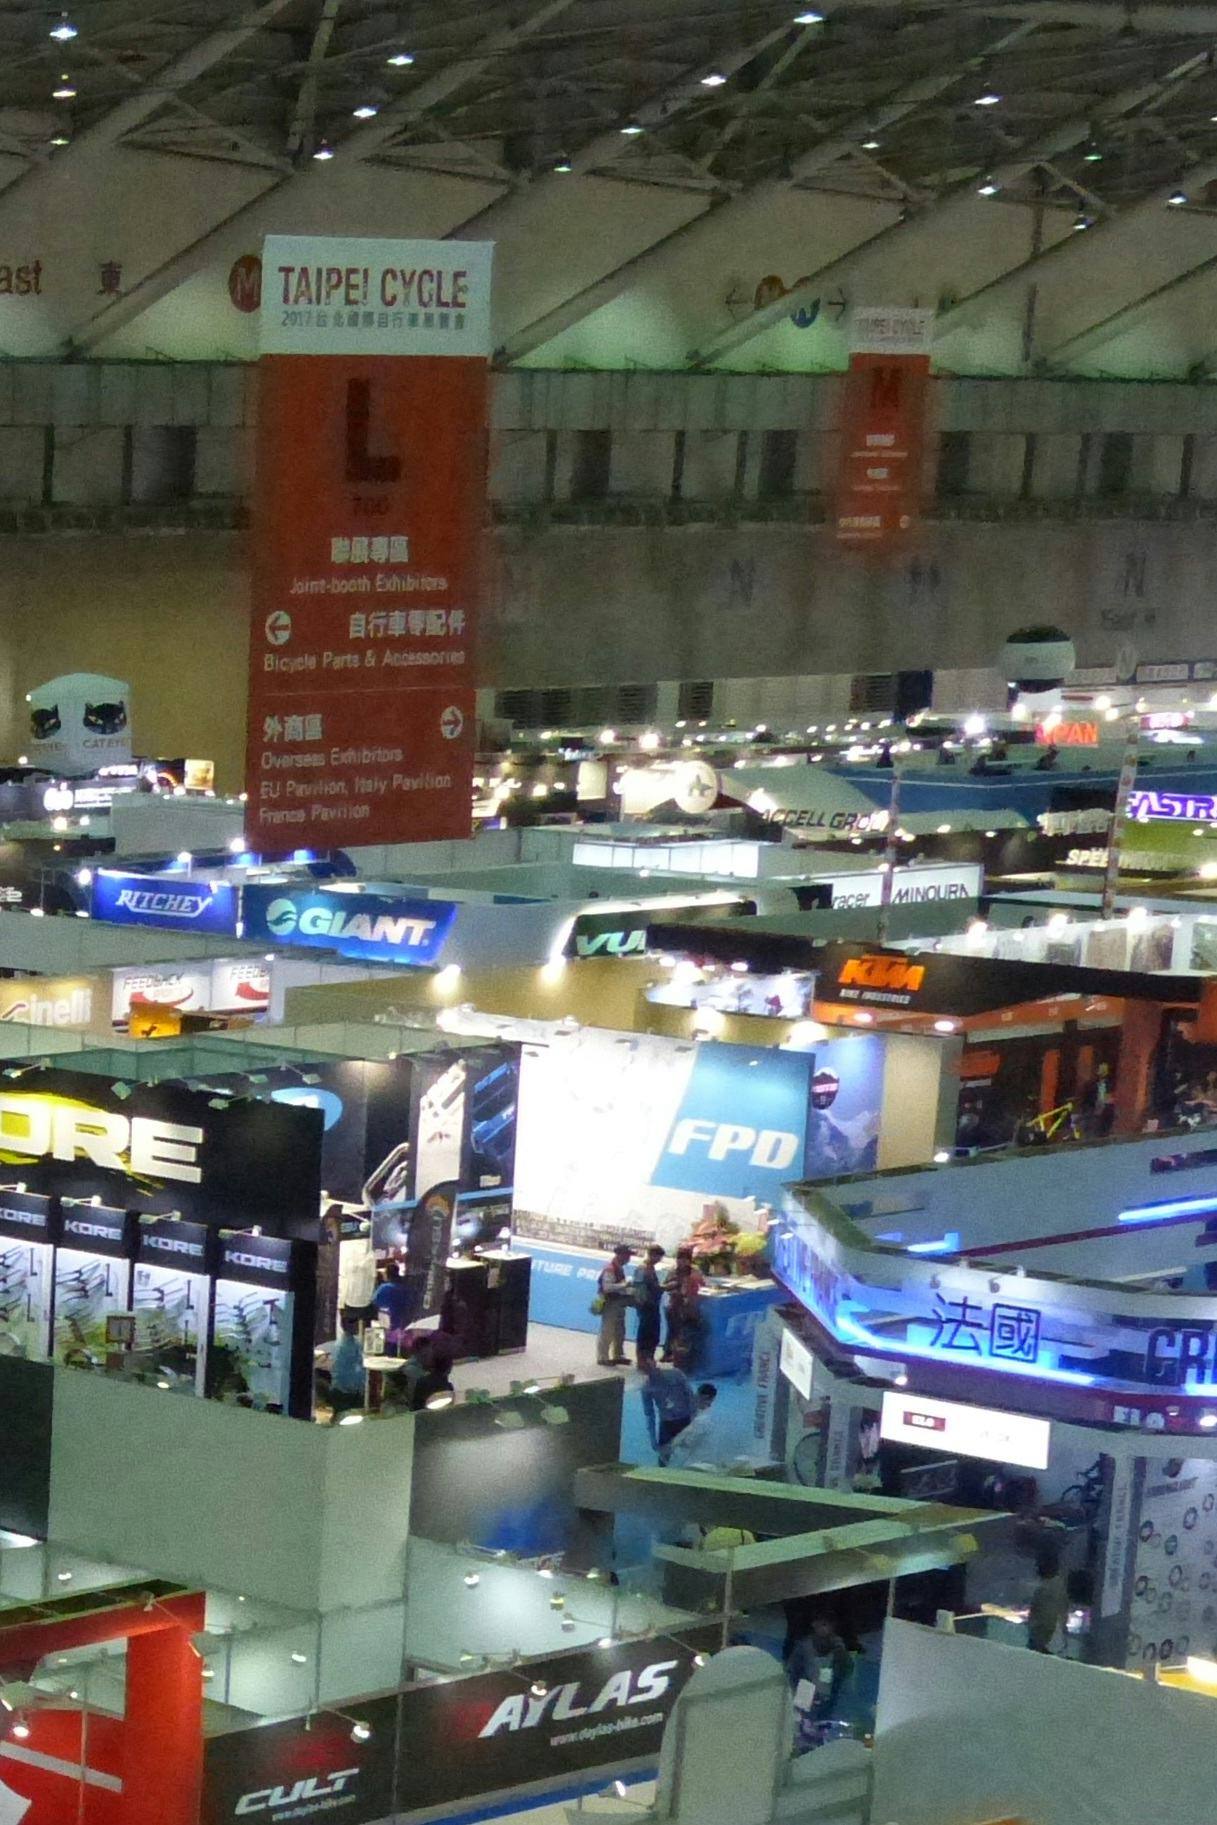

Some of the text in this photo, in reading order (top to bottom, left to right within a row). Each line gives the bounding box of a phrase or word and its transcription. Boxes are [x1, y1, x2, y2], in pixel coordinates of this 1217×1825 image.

[98, 260, 124, 297] 東
[278, 266, 469, 309] TAIPEI CYCLE
[345, 377, 403, 484] L
[375, 574, 448, 592] Exhibitors
[264, 649, 466, 673] Bicycle Parts & Accessories
[261, 747, 403, 770] Overseas Exhibitors
[260, 781, 281, 799] EU
[355, 775, 386, 795] Italy
[392, 773, 452, 790] Pavilion
[259, 803, 371, 824] France Pavilion
[115, 889, 214, 919] RITCHEY
[892, 882, 970, 904] MINOURA
[298, 907, 438, 947] GIANT
[837, 954, 927, 991] KTM
[668, 1119, 800, 1170] FPD
[63, 1218, 124, 1242] KORE
[142, 1233, 204, 1258] KORE
[224, 1249, 289, 1274] KORE
[929, 1291, 1042, 1364] 法國
[478, 1659, 679, 1740] AYLAS
[234, 1767, 360, 1816] CULT
